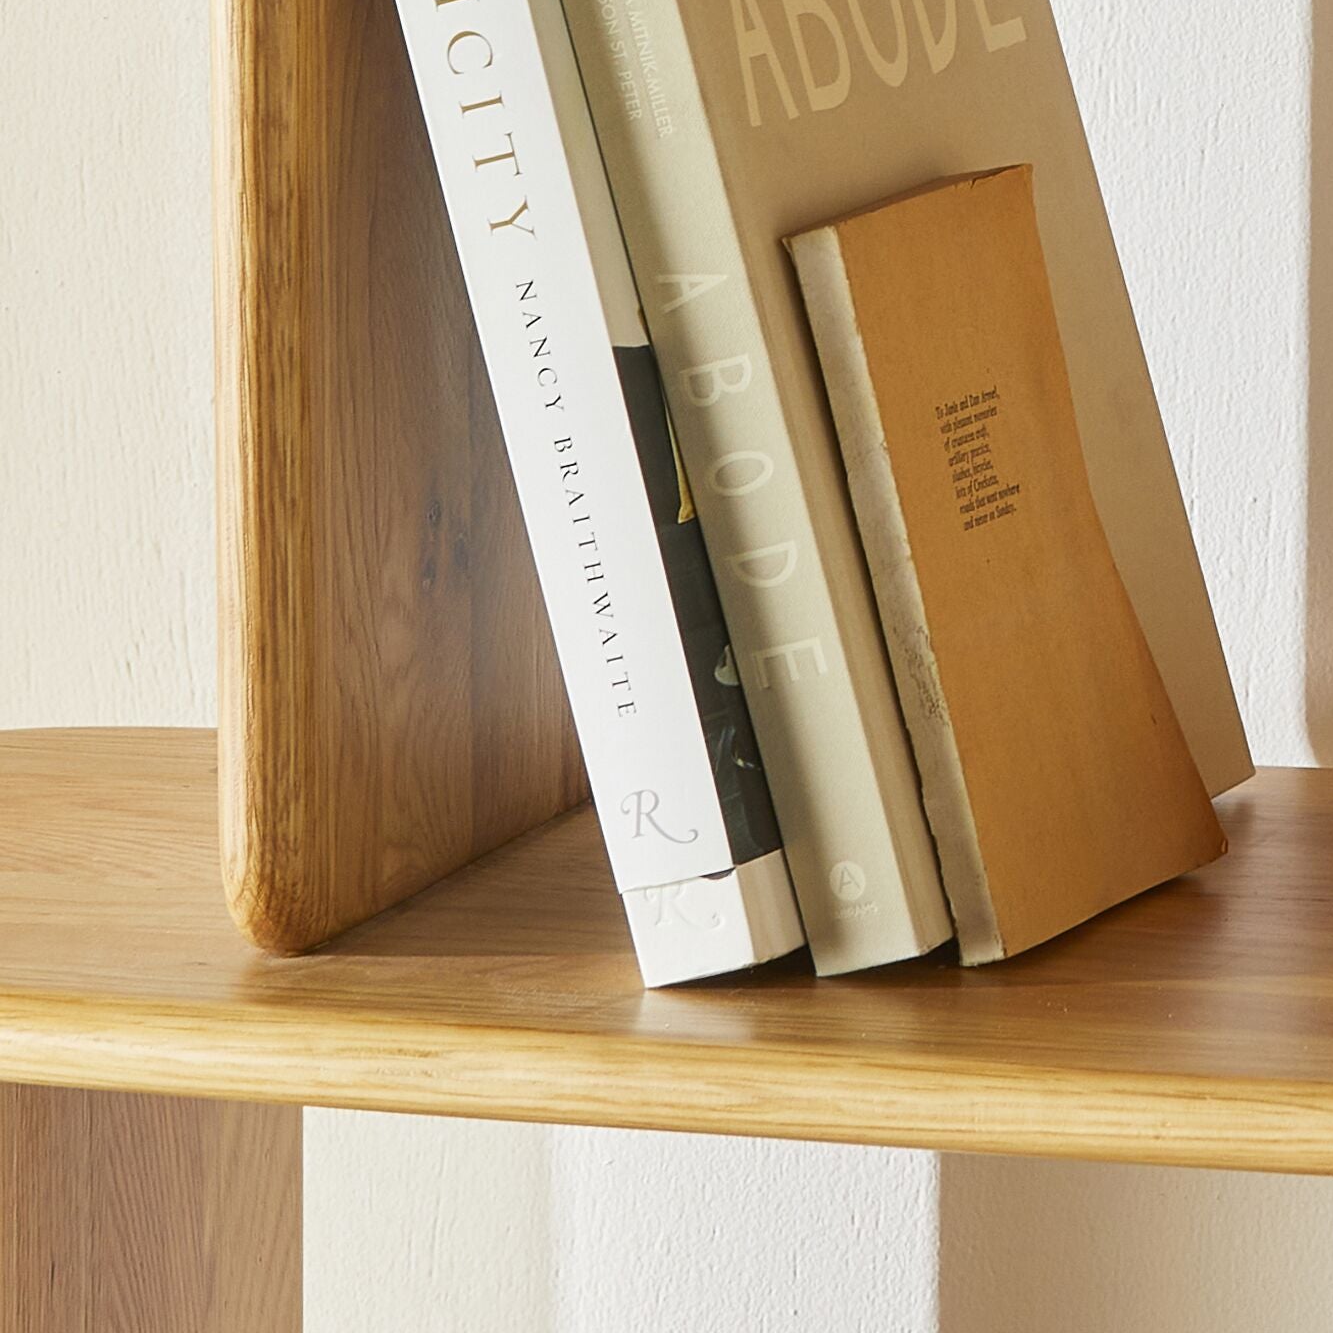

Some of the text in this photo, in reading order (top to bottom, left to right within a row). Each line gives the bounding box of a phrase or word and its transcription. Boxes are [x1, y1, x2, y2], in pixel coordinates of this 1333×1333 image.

[618, 70, 643, 121] PETER
[514, 277, 638, 720] NANCY BRAITHWAITE
[656, 272, 828, 693] ABODE
